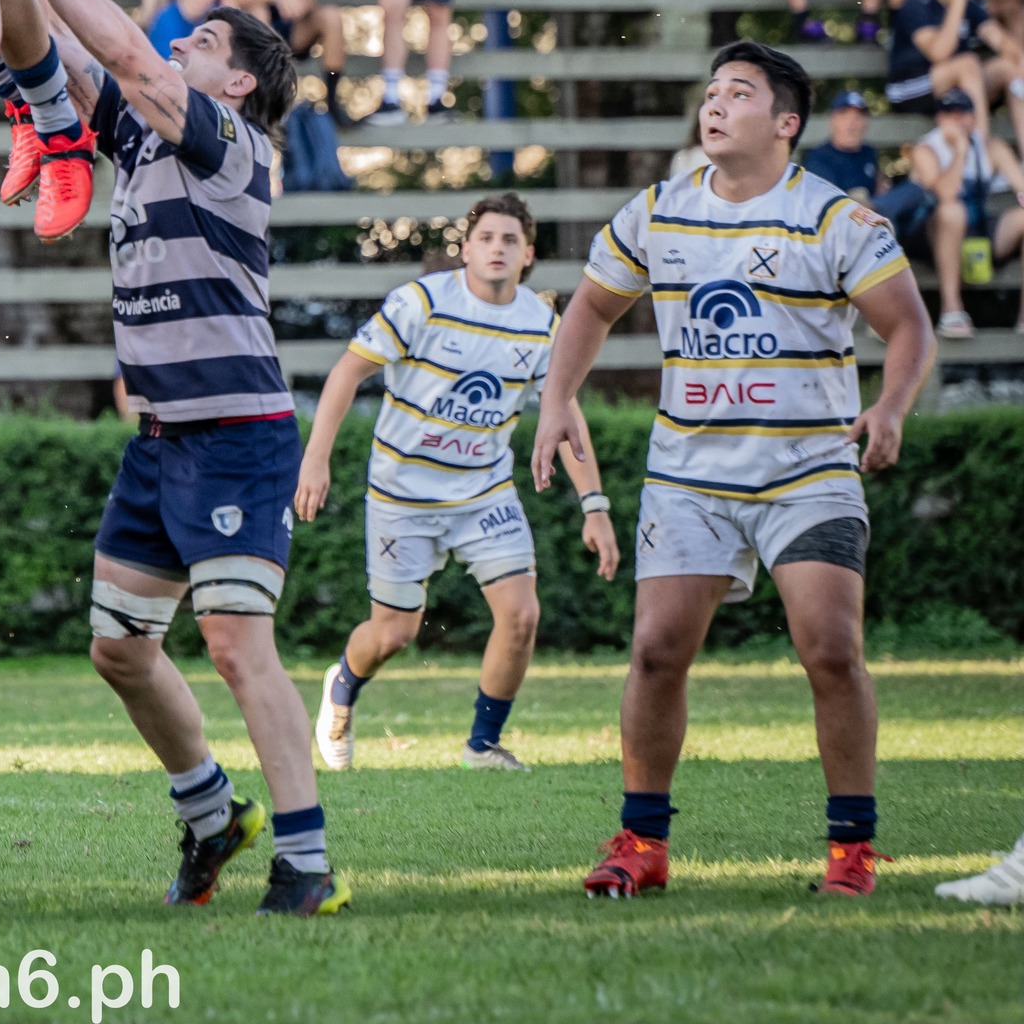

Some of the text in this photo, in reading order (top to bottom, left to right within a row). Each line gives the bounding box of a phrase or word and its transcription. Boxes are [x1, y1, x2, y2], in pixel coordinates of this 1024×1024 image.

[680, 326, 777, 356] Macro
[685, 382, 776, 405] BAIC
[430, 397, 504, 426] Macro
